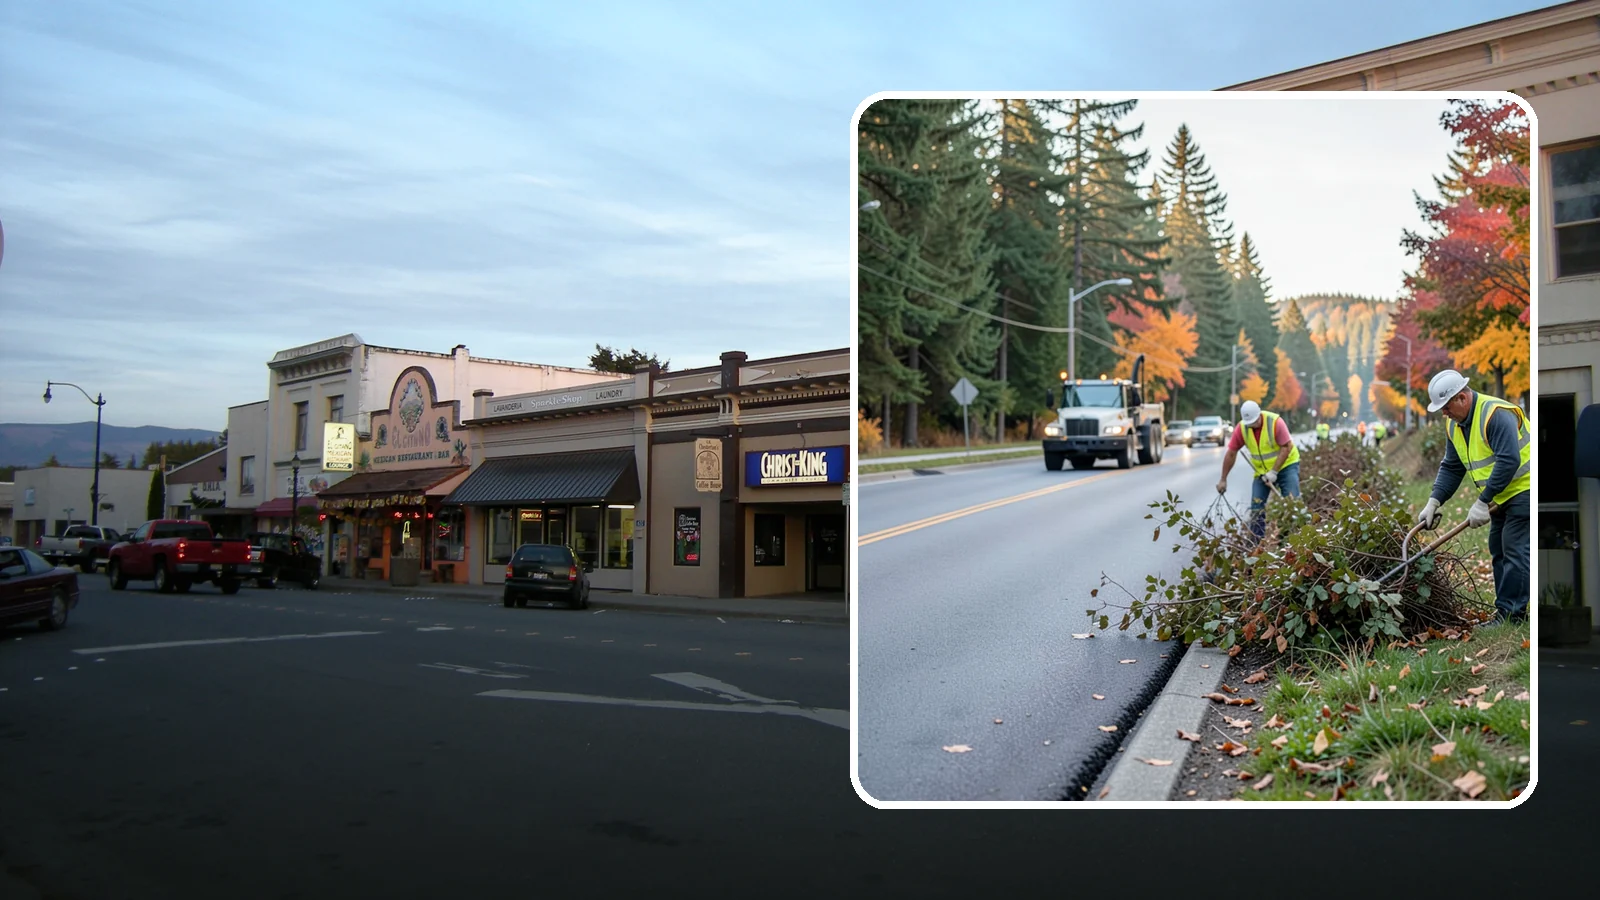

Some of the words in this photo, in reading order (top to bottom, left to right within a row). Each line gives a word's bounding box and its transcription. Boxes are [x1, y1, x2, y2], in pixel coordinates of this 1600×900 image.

[494, 402, 523, 412] LAVANDERIA
[596, 389, 623, 400] LAUNDRY
[374, 456, 396, 464] MEXICAN
[398, 451, 433, 462] RESTAURANT
[438, 450, 450, 459] BAR
[761, 452, 798, 478] CHRIST
[799, 450, 827, 476] KING
